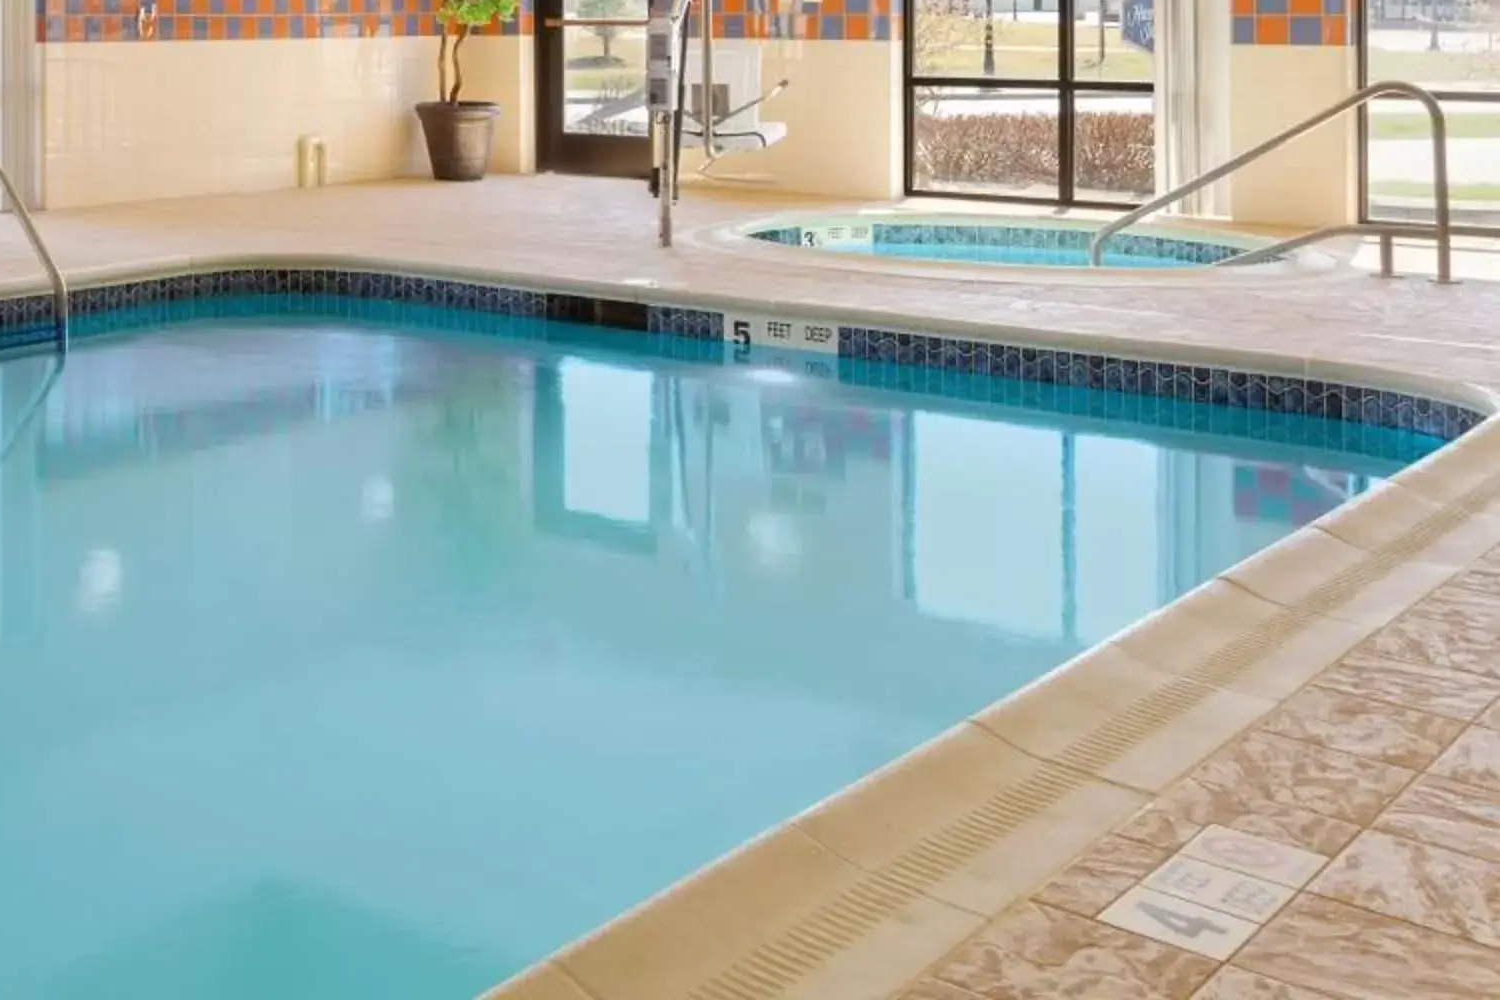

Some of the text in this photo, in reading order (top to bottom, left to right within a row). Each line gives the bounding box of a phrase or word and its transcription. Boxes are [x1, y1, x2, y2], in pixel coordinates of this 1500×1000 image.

[733, 320, 833, 346] 5 FEET DEEP
[1134, 899, 1231, 940] 4
